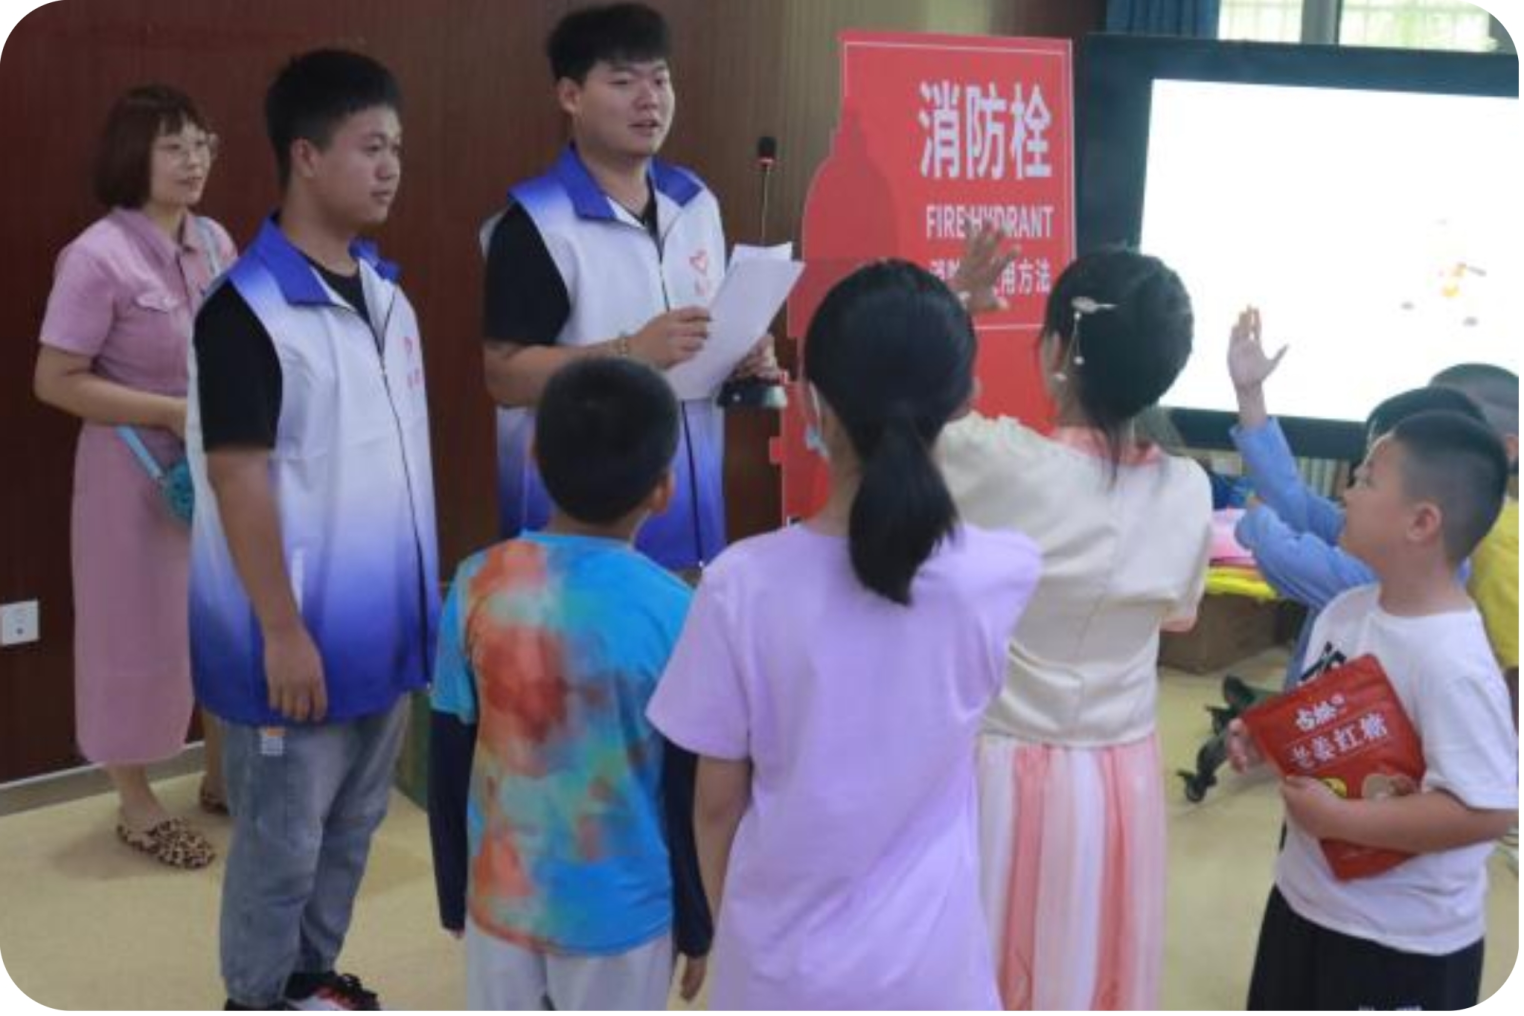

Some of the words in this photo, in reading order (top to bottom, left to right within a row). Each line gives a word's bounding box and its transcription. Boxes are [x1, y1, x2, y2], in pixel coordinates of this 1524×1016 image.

[919, 82, 1052, 180] 消防栓
[927, 206, 965, 238] FIRE
